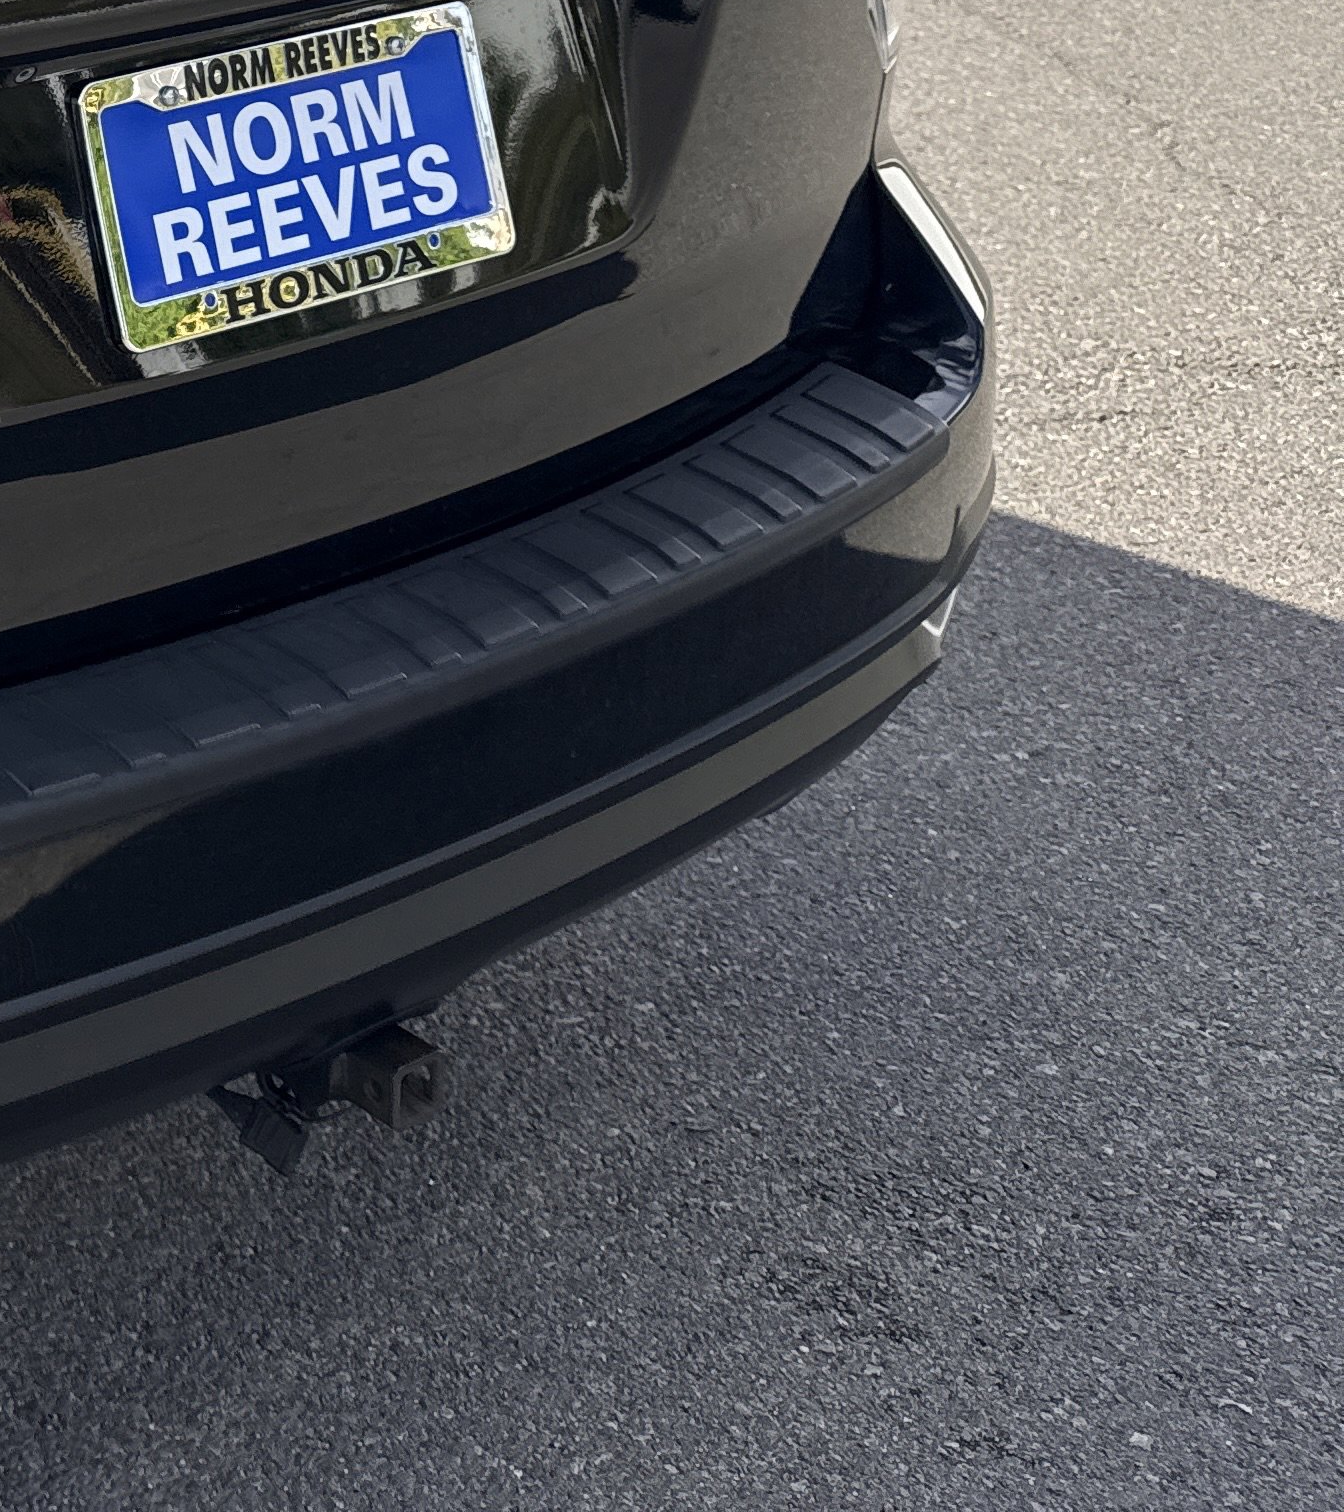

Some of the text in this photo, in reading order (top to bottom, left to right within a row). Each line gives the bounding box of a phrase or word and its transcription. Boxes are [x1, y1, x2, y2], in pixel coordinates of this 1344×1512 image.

[184, 25, 381, 101] NORM REEVES
[167, 70, 415, 194] NORM
[153, 144, 458, 285] REEVES
[220, 241, 437, 323] HONDA
